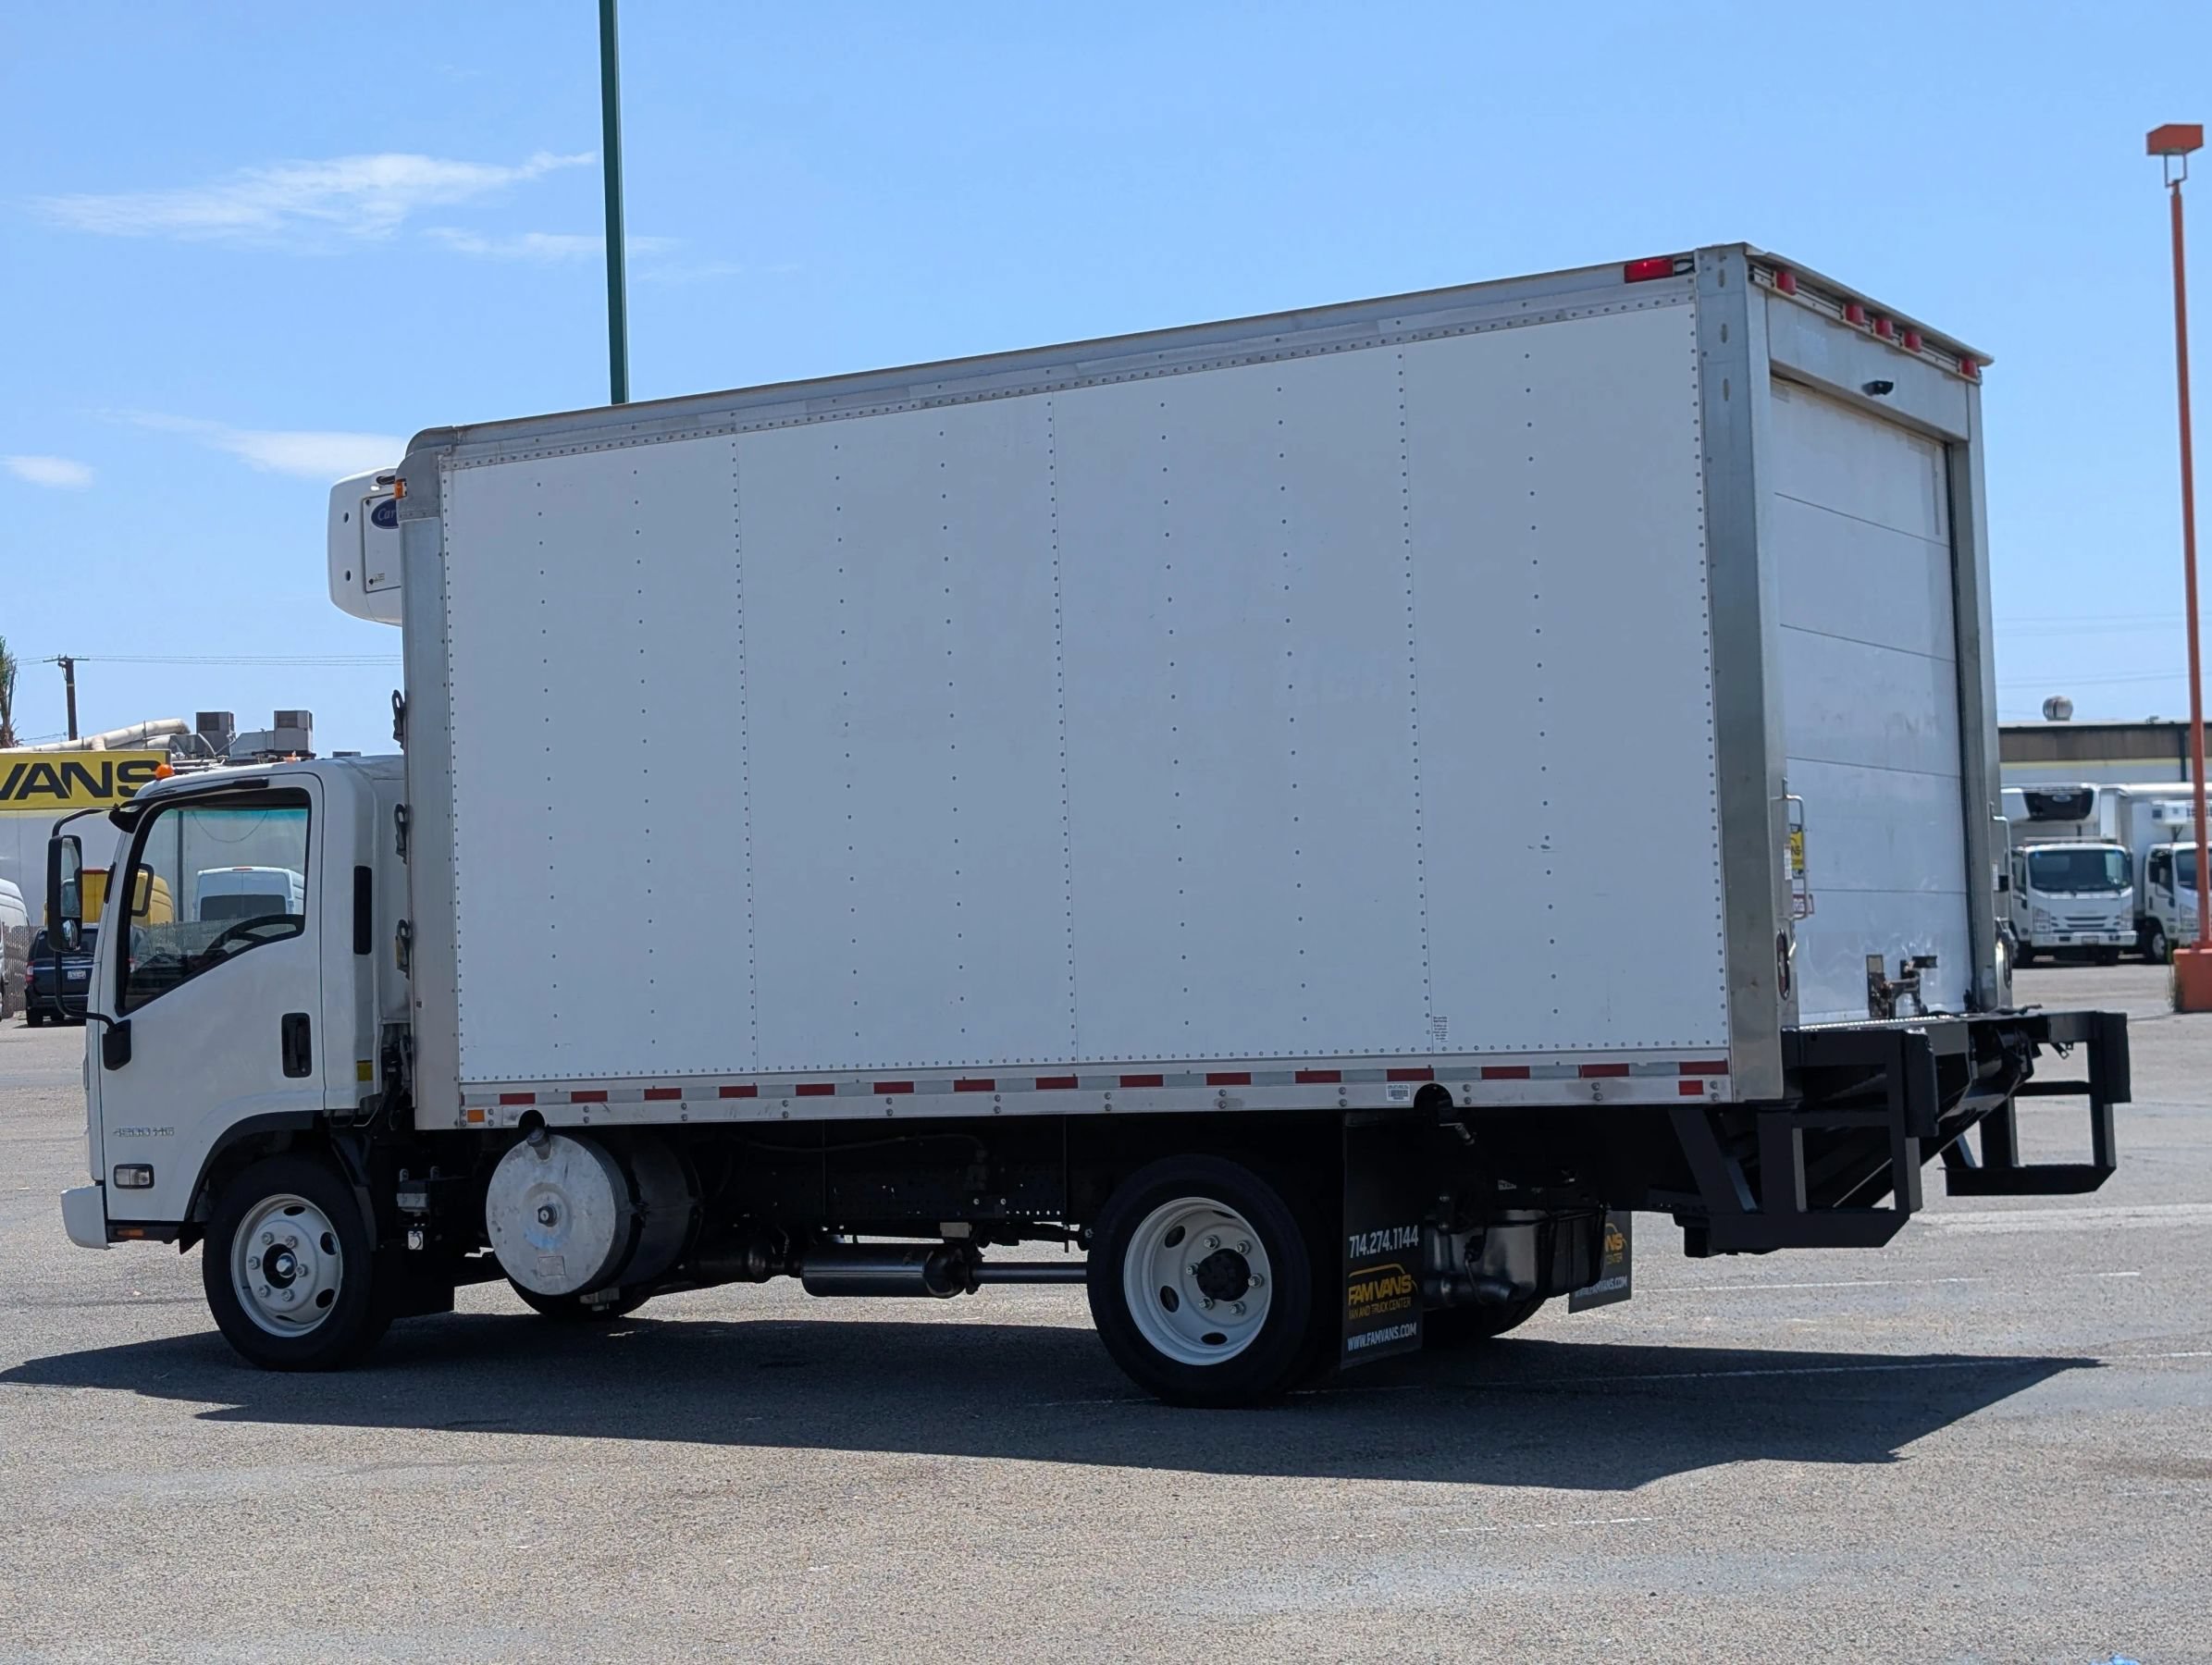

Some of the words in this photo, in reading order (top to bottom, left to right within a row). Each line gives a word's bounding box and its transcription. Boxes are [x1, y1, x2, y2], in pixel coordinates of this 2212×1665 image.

[1349, 1225, 1418, 1258] 714.274.1144
[1348, 1281, 1373, 1306] FAM
[1374, 1274, 1412, 1299] VANS
[1390, 1296, 1412, 1311] CENTER
[1347, 1323, 1416, 1351] WWW.FAMVANS.COM
